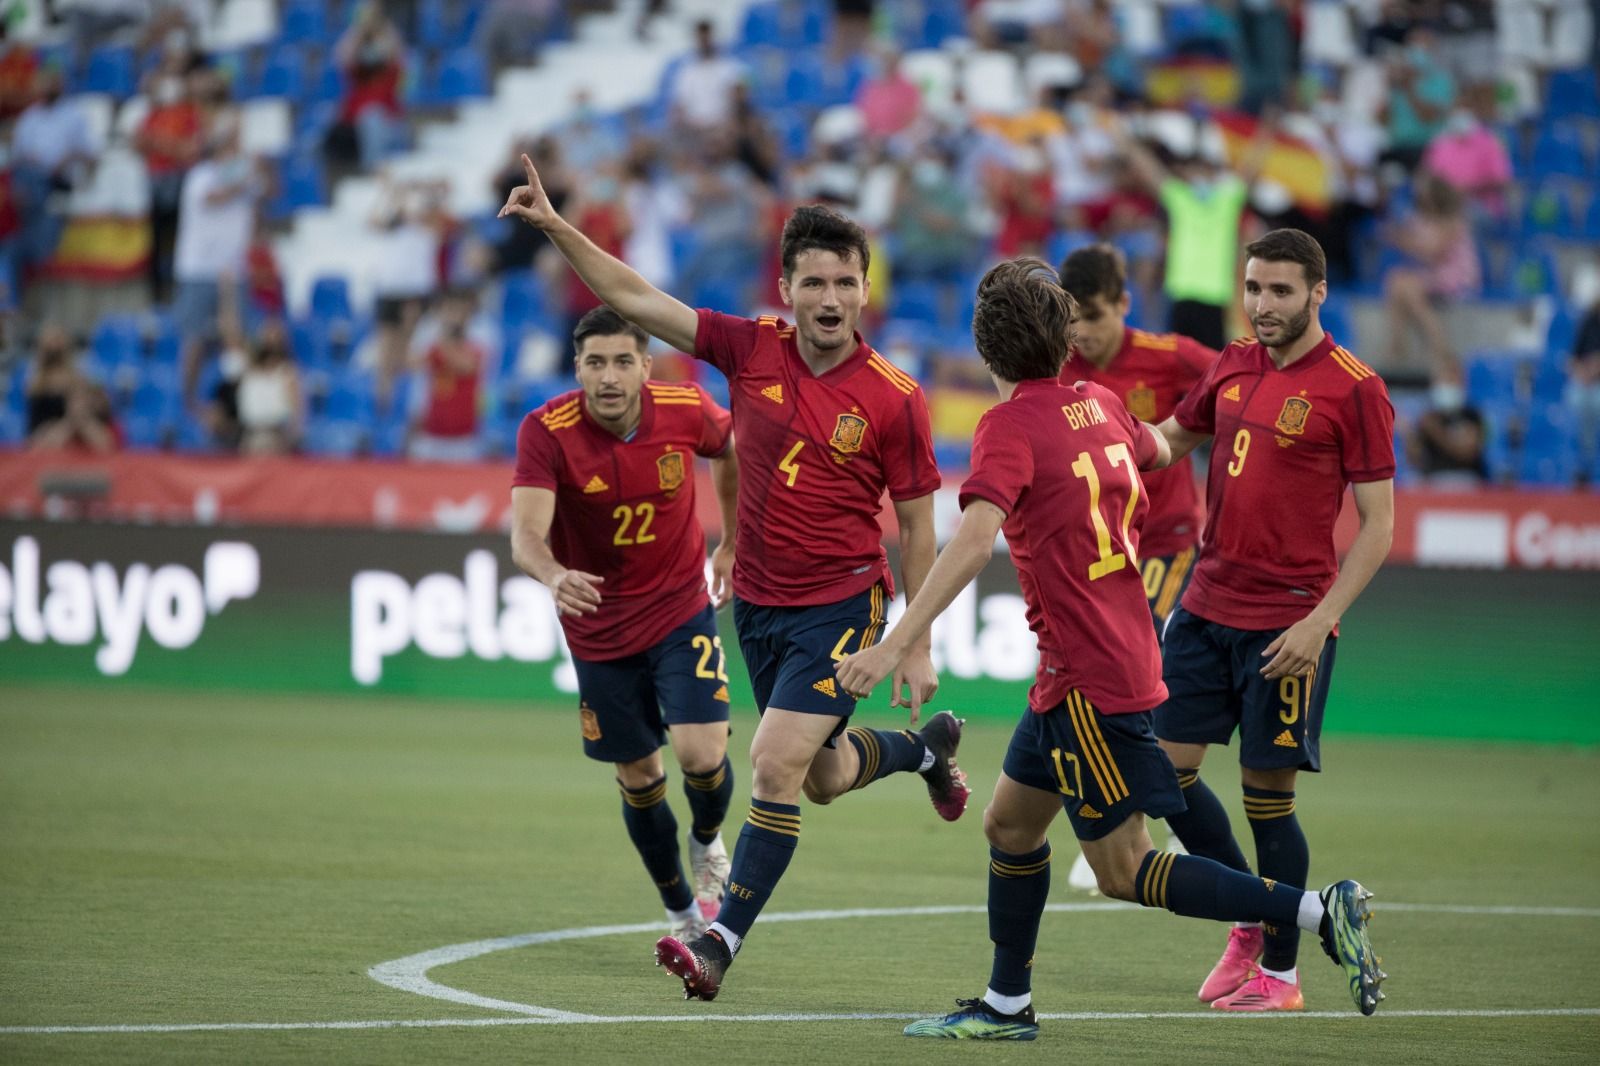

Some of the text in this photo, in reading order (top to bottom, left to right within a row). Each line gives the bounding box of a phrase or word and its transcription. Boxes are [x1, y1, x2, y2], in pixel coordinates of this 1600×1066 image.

[1062, 398, 1108, 430] BRYAN
[779, 440, 805, 487] 4
[1228, 429, 1251, 477] 9
[613, 502, 656, 546] 22
[1071, 442, 1139, 581] 17
[1279, 675, 1300, 725] 9
[1051, 747, 1083, 800] 17
[730, 881, 755, 900] RFEF
